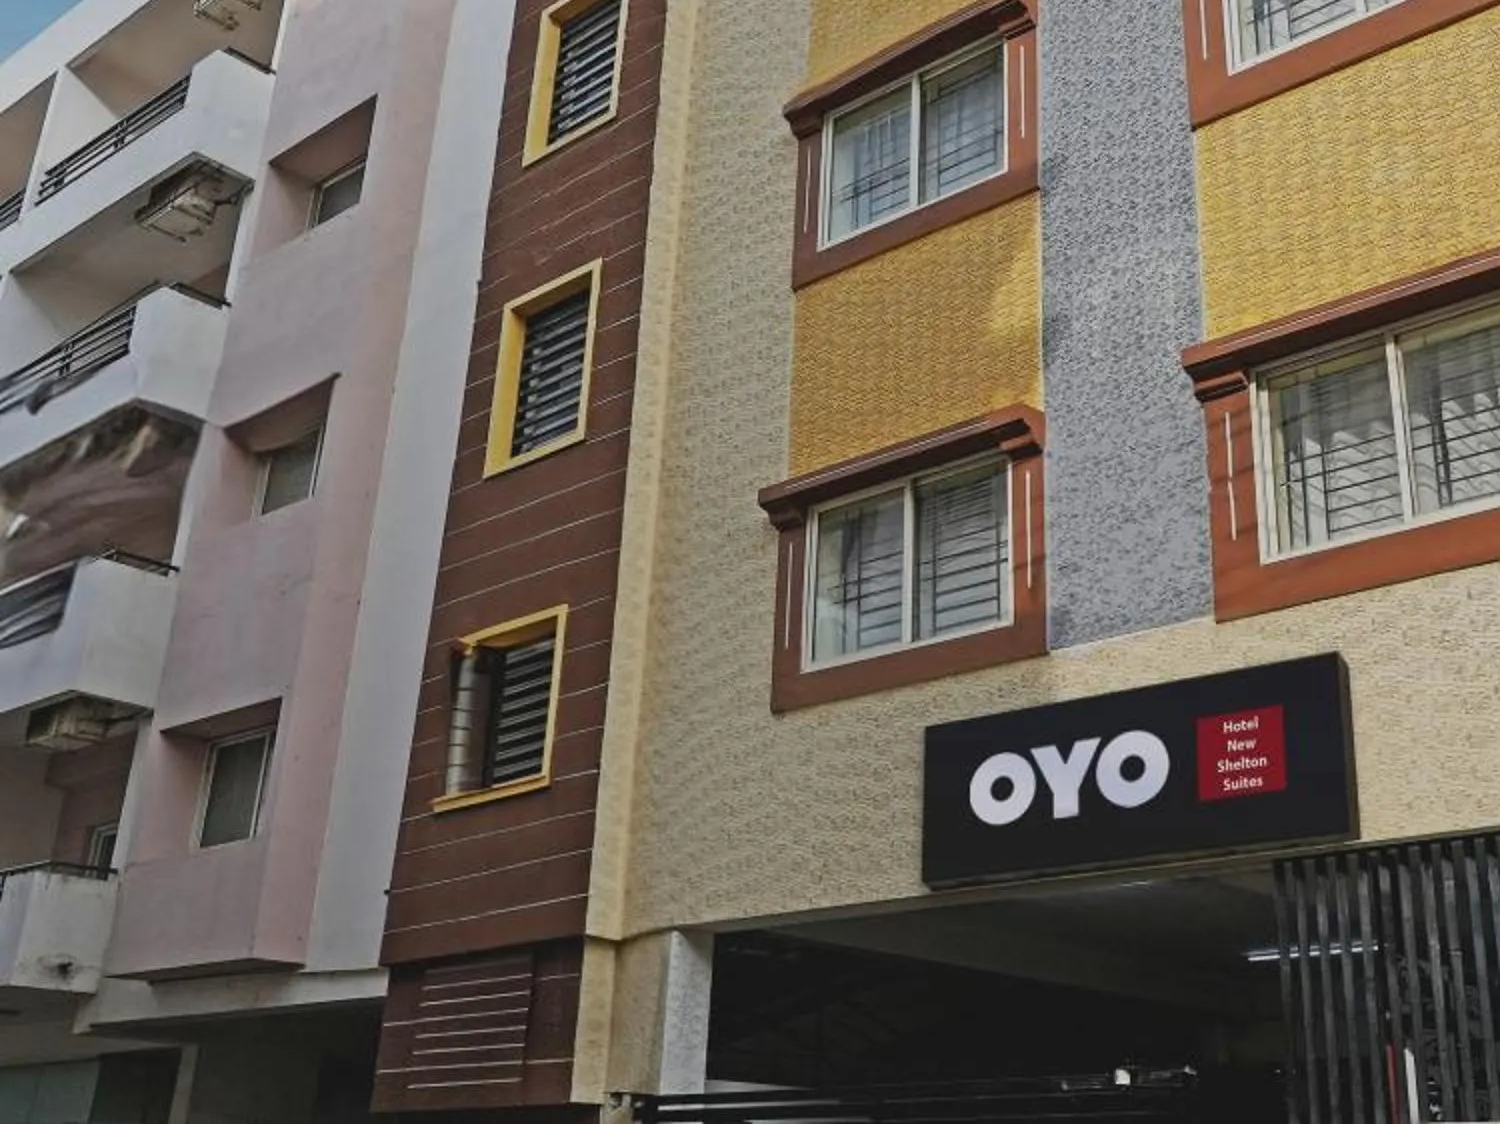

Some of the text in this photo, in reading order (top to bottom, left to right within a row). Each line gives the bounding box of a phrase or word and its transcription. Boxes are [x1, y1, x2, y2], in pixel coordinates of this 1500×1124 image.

[1223, 716, 1259, 733] Hotel
[1227, 737, 1257, 751] New
[1217, 755, 1268, 773] Shelton
[969, 730, 1170, 825] OYO
[1223, 774, 1264, 791] Suites
